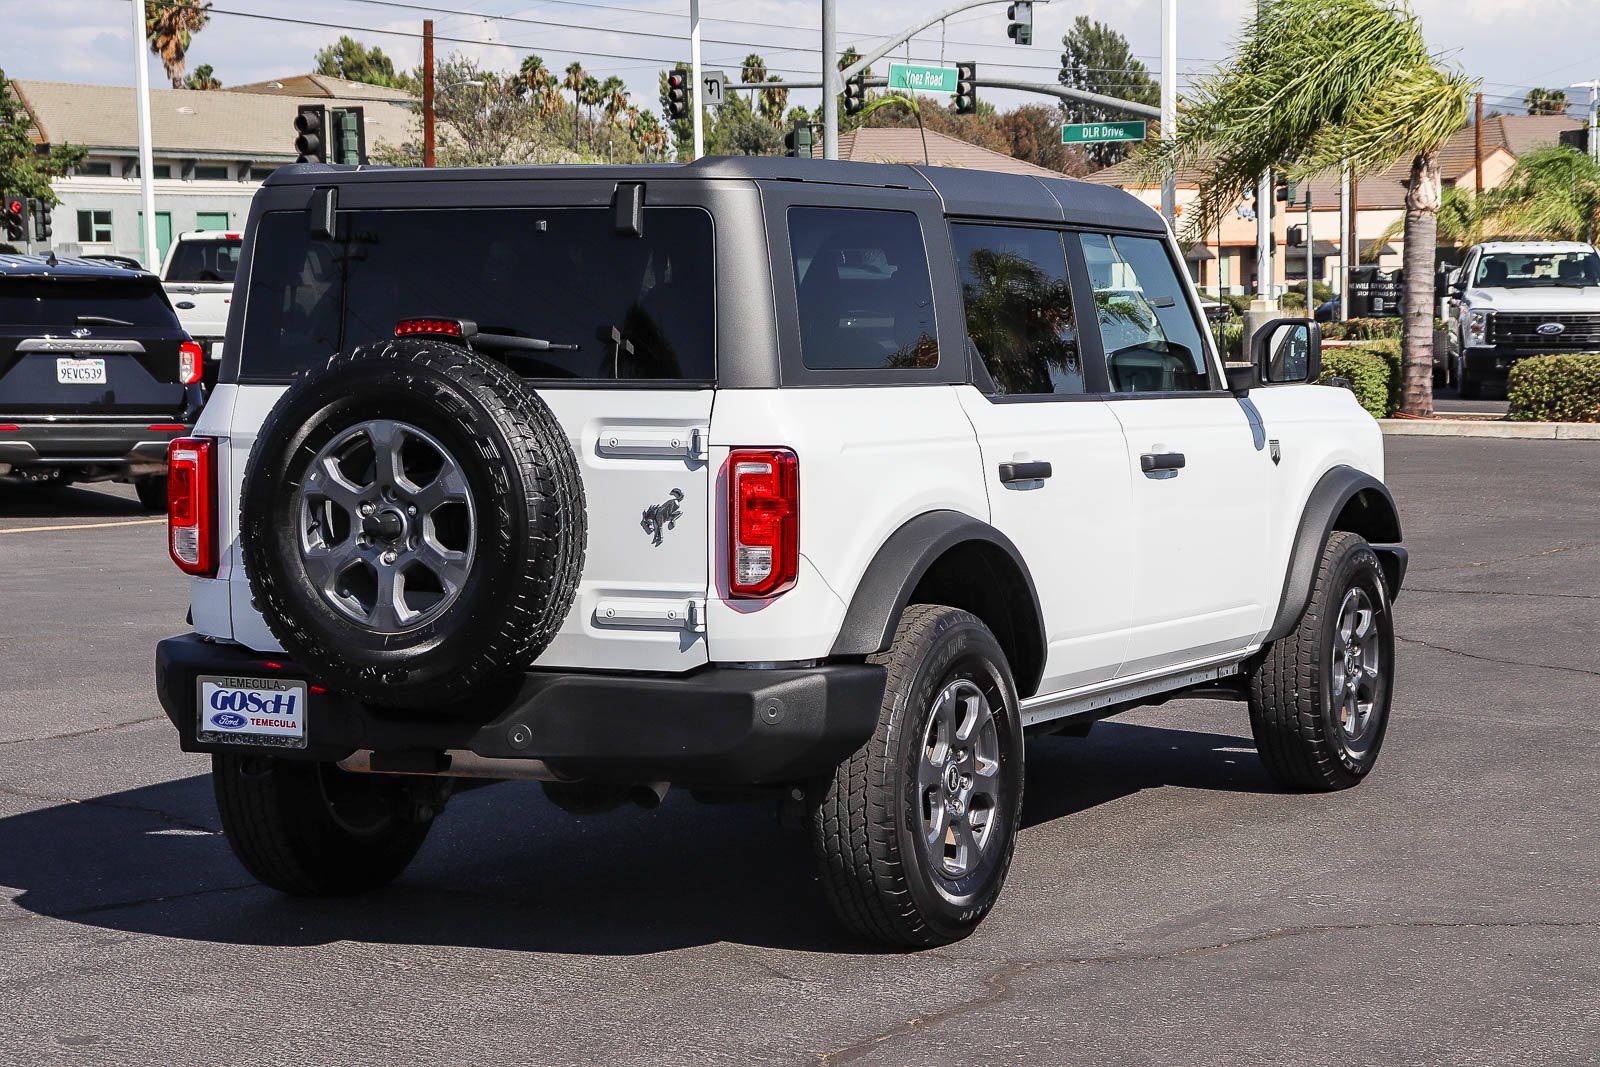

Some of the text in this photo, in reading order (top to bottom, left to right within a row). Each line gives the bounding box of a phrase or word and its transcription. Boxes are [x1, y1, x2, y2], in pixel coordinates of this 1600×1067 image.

[906, 69, 944, 86] Ynez Road
[1082, 126, 1124, 138] DLR Drive
[61, 368, 102, 379] 9EVC539
[223, 677, 281, 690] TEMECULA
[218, 714, 240, 727] Ford
[250, 718, 297, 729] TEMECULA
